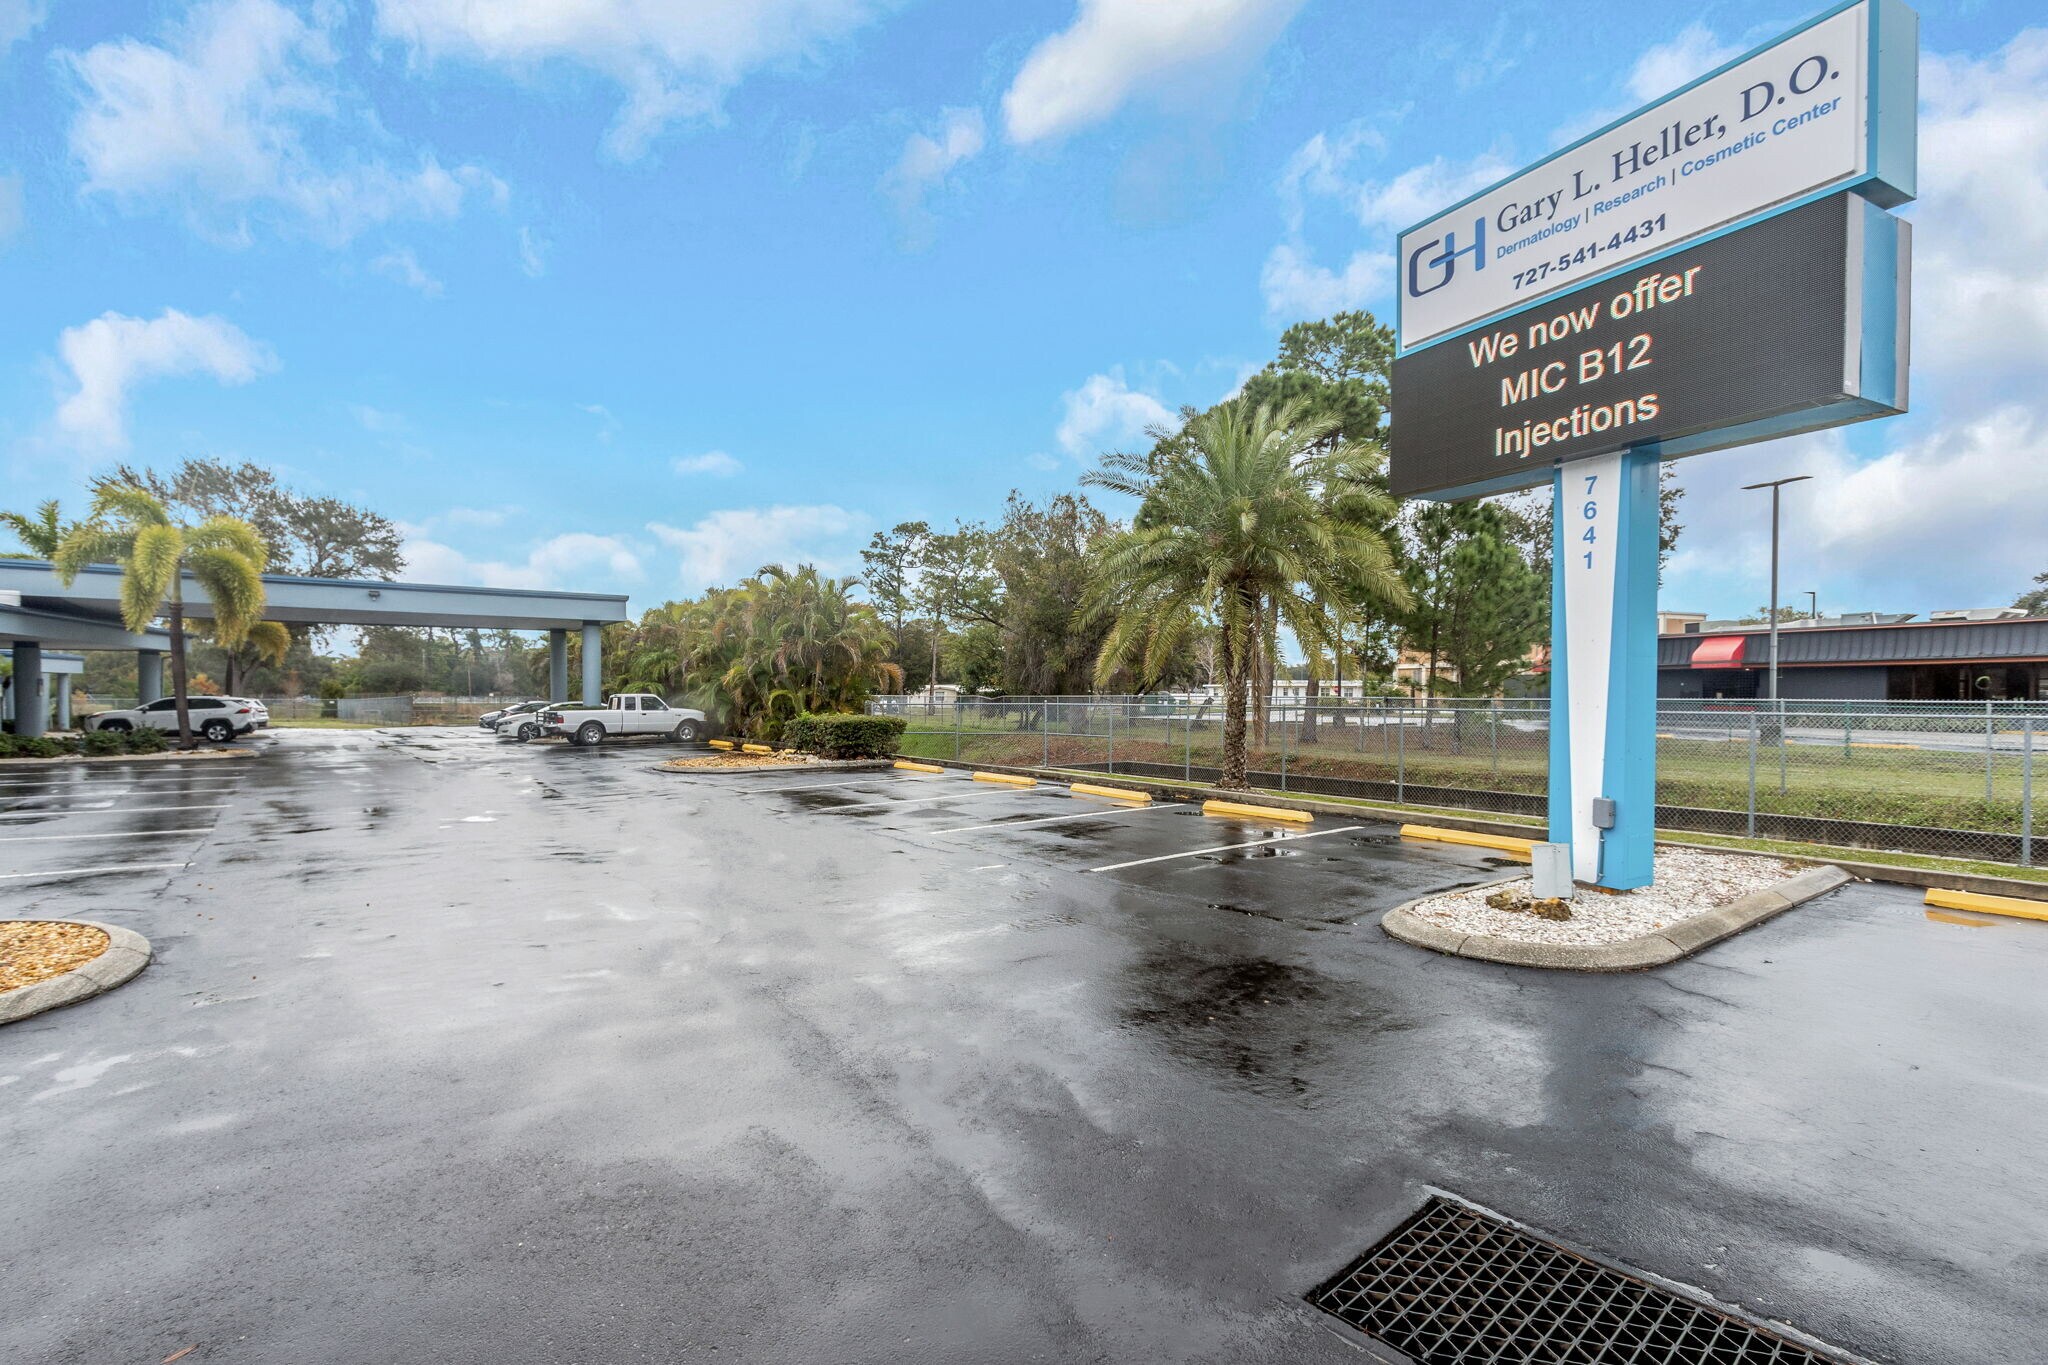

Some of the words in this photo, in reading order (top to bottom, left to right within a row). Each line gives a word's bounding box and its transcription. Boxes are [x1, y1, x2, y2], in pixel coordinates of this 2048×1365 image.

[1496, 188, 1564, 234] Gary
[1572, 170, 1600, 202] L.
[1611, 112, 1727, 183] Heller,
[1739, 54, 1840, 122] D.O.
[1496, 214, 1582, 259] Dermatology
[1593, 174, 1666, 216] Research
[1680, 130, 1766, 177] Cosmetic
[1772, 96, 1842, 136] Center
[1512, 213, 1667, 291] 727-541-4431
[1468, 331, 1518, 368] We
[1528, 302, 1600, 348] now
[1609, 264, 1702, 321] offer
[1500, 361, 1567, 407] MIC
[1578, 333, 1654, 385] B12
[1494, 393, 1660, 459] Injections
[1582, 475, 1598, 570] 7641
